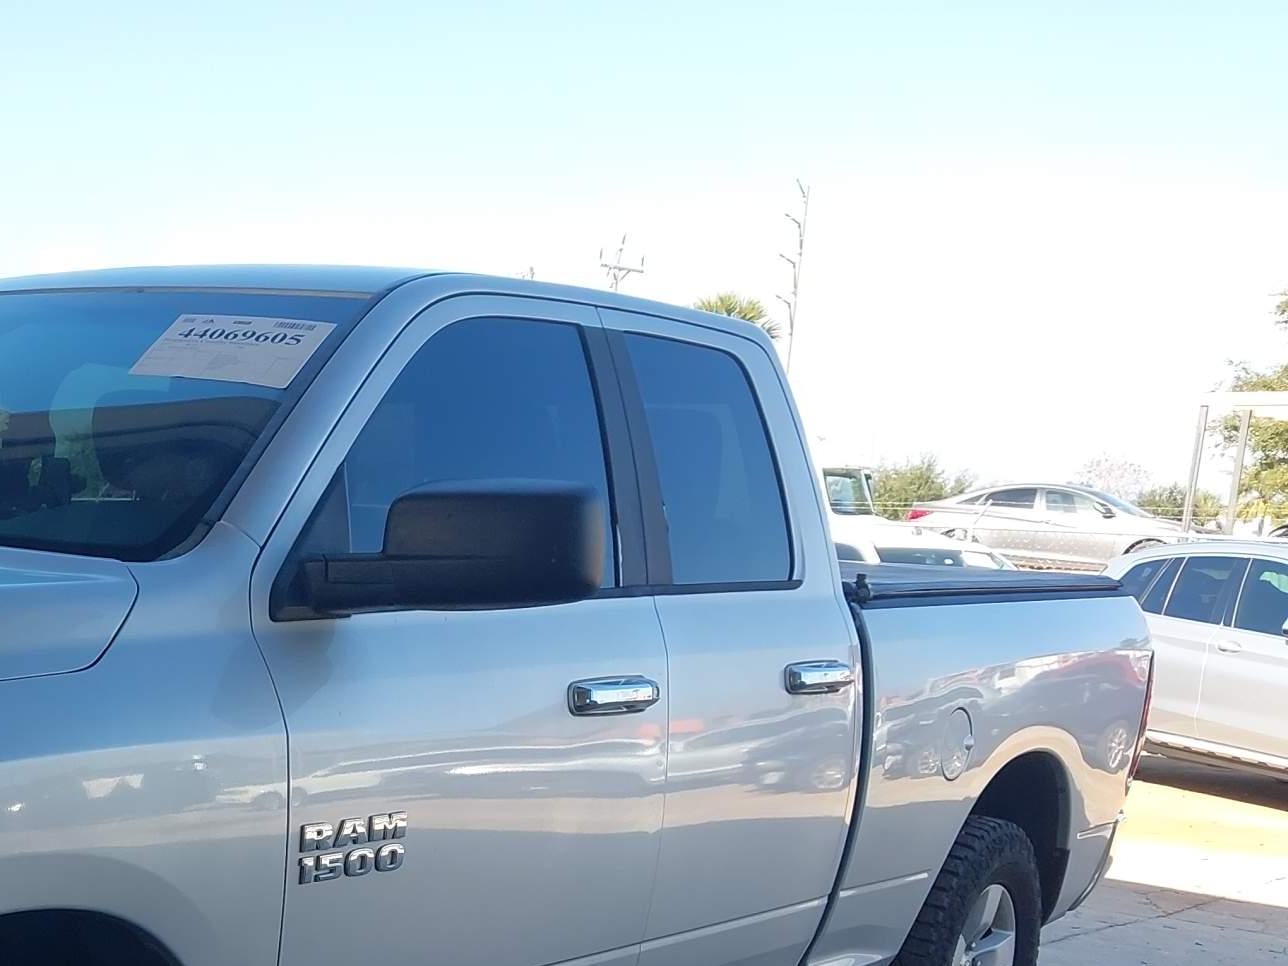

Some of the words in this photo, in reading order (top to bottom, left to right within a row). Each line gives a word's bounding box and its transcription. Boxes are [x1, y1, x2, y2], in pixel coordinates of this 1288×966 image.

[179, 327, 305, 346] 44069605
[299, 811, 408, 852] RAM
[298, 843, 405, 884] 1500
